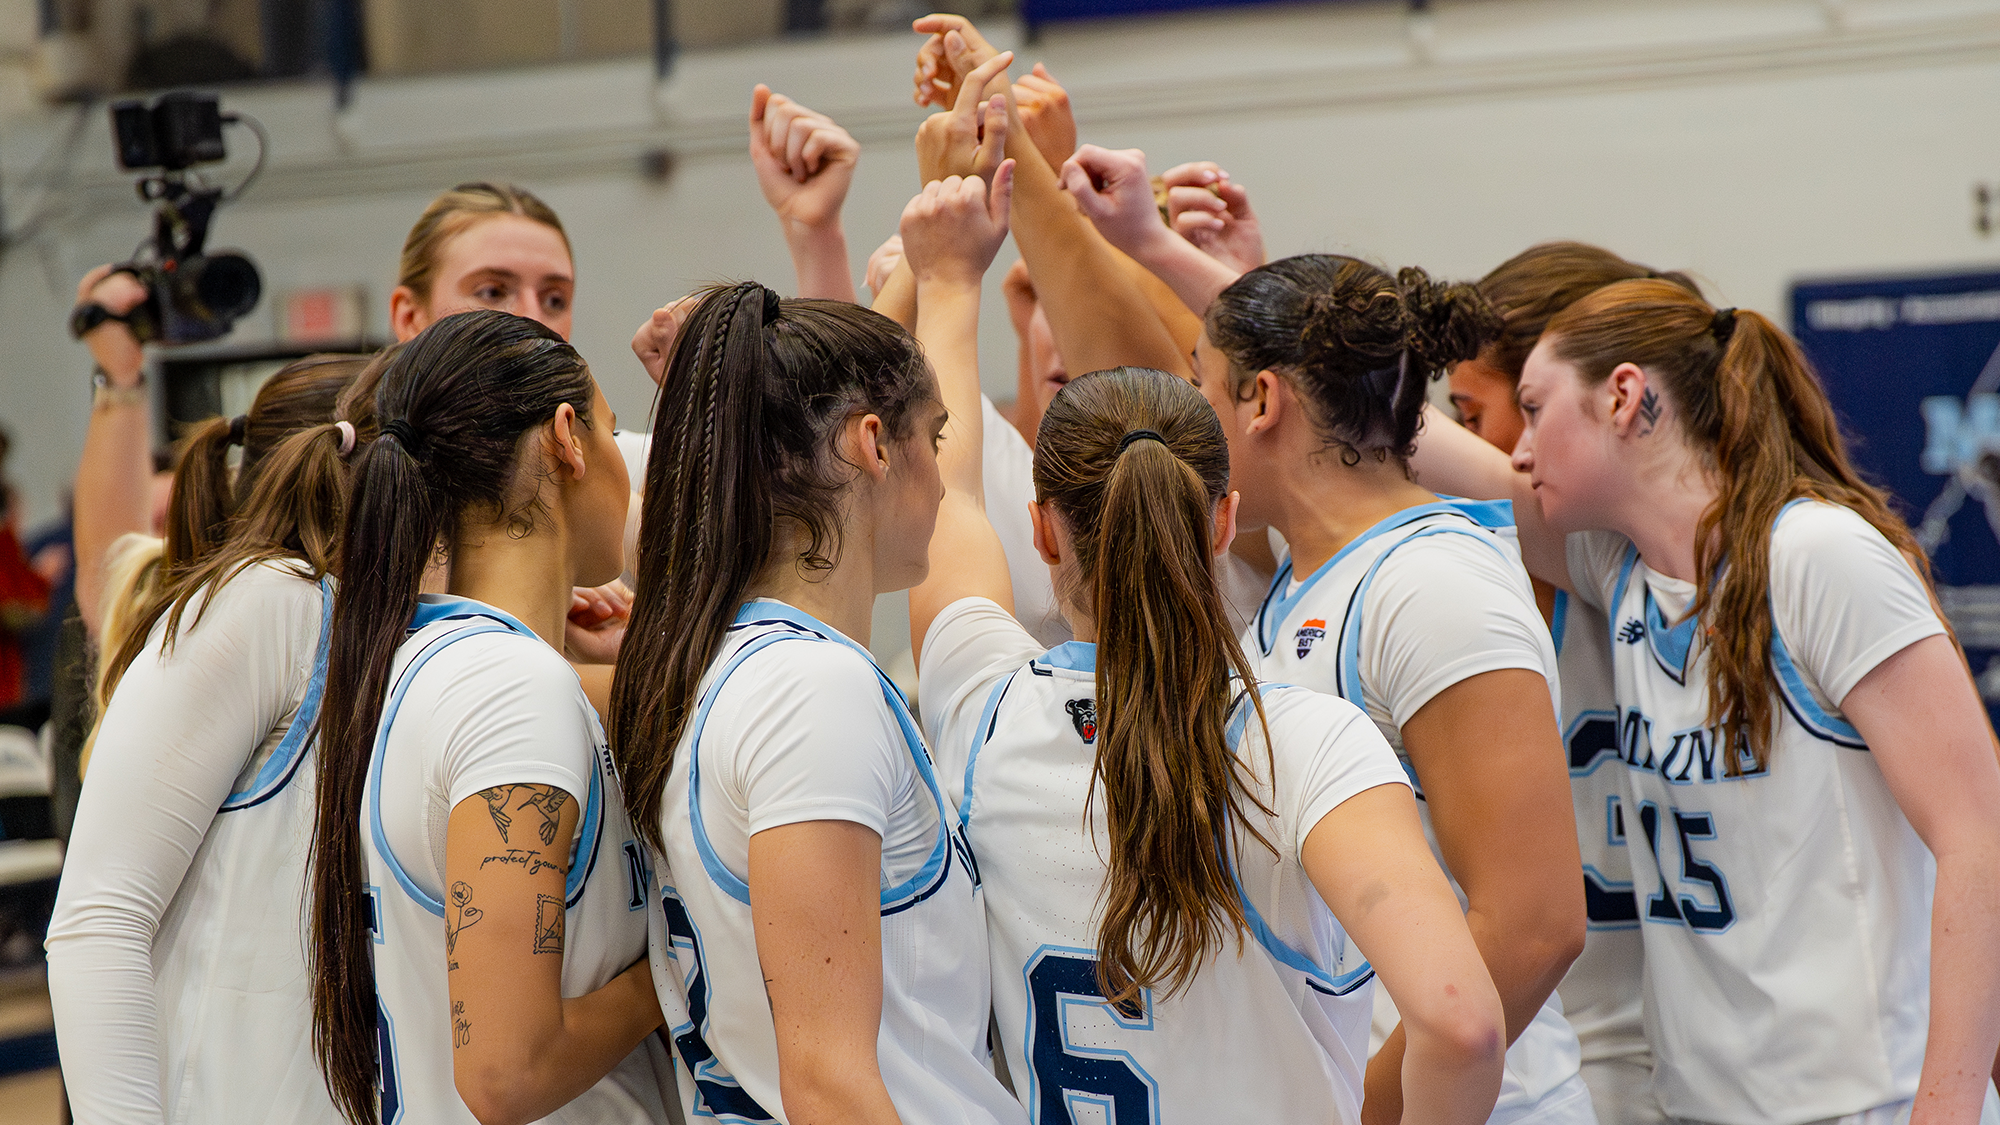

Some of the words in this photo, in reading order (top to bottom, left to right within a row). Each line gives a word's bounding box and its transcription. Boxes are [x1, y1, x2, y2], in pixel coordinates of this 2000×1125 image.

[1616, 706, 1771, 786] MIN
[479, 849, 542, 871] protect
[529, 858, 559, 876] your
[1637, 800, 1738, 935] 15
[1022, 943, 1162, 1125] 6
